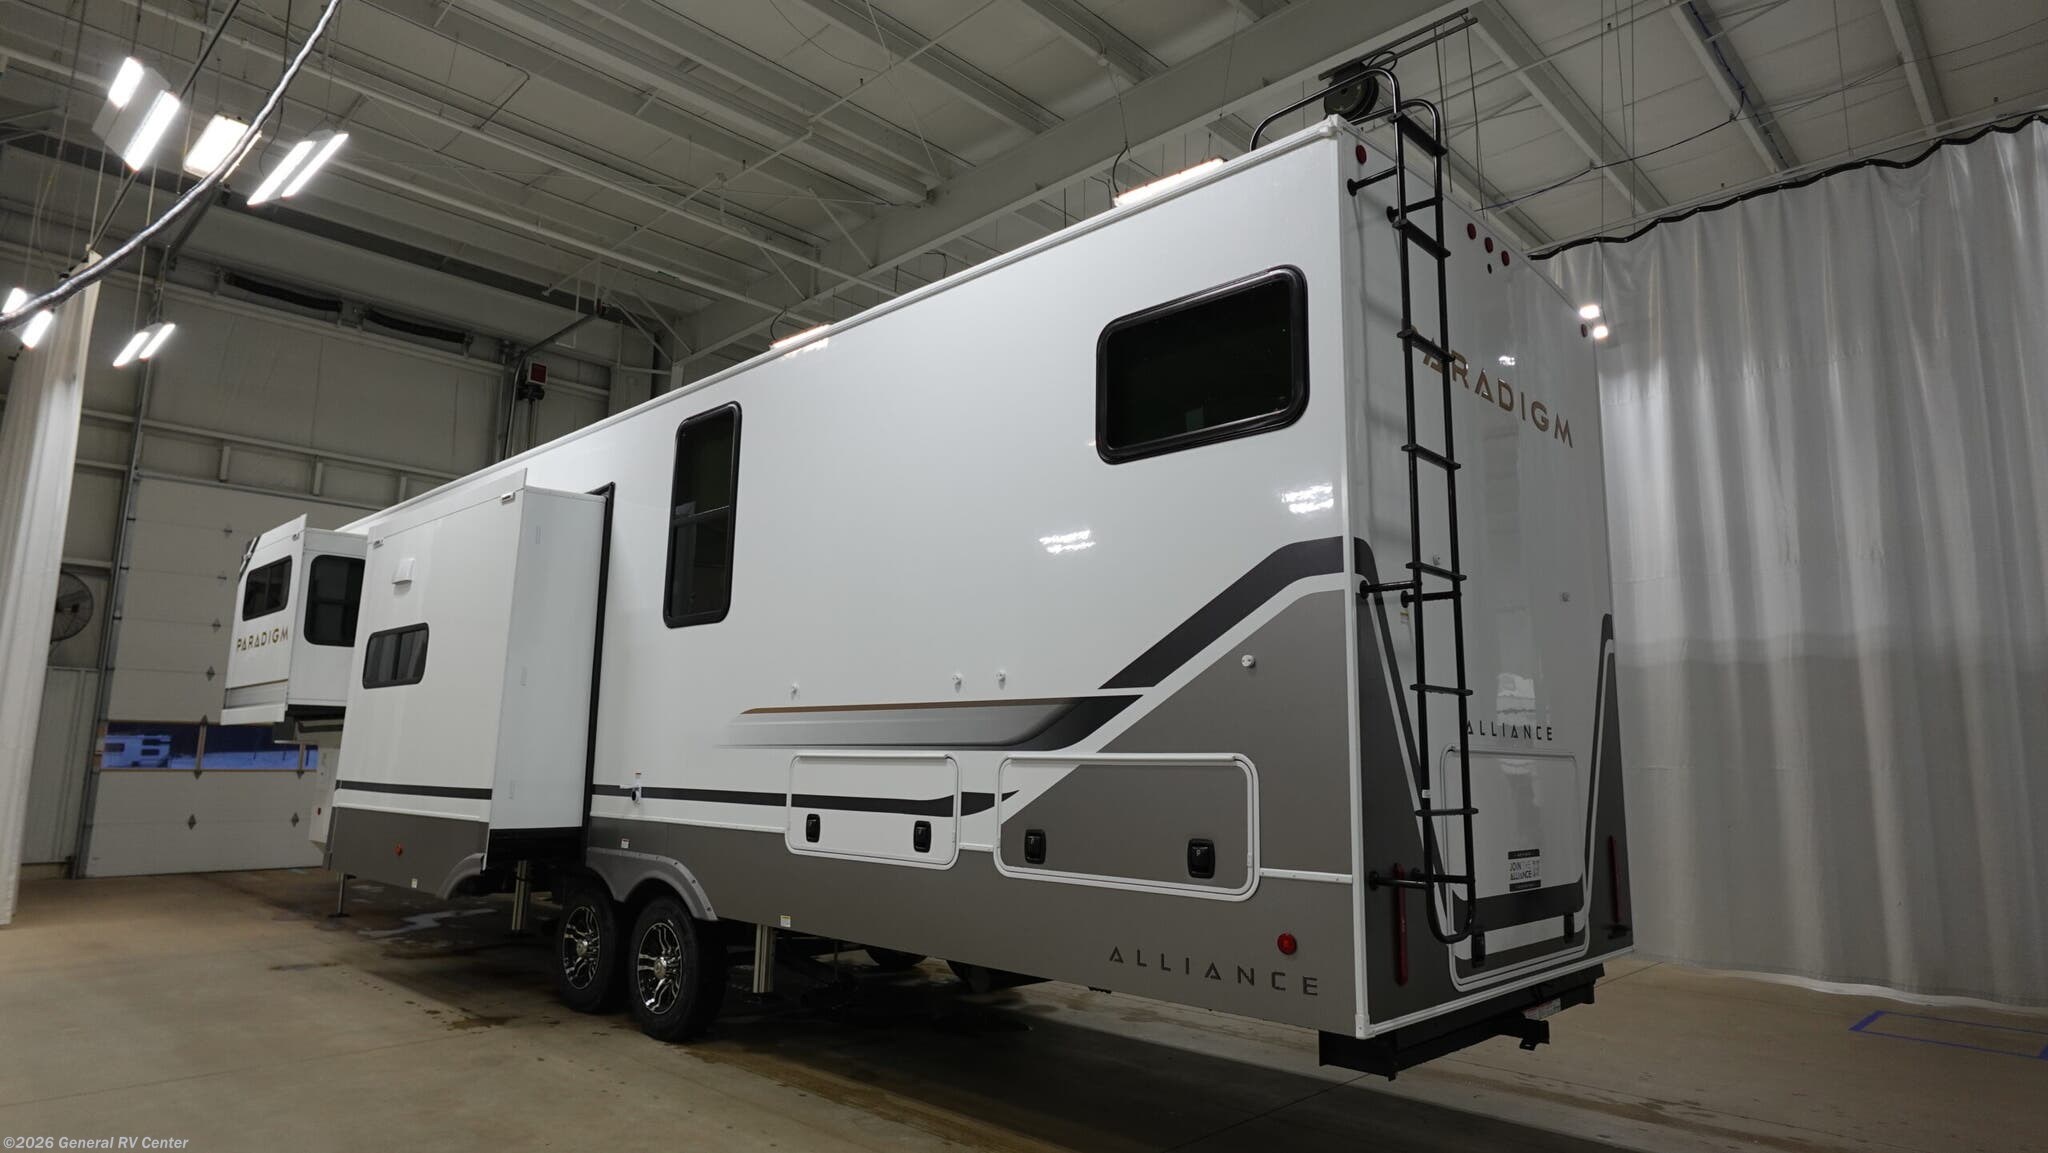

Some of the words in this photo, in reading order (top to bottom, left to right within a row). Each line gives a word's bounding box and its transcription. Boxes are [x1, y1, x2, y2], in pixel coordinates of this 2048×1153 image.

[1408, 325, 1573, 449] ARADIGM
[236, 626, 289, 652] PARADIGM
[1466, 719, 1553, 741] ALLIANCE
[1108, 946, 1319, 996] ALLIANCE
